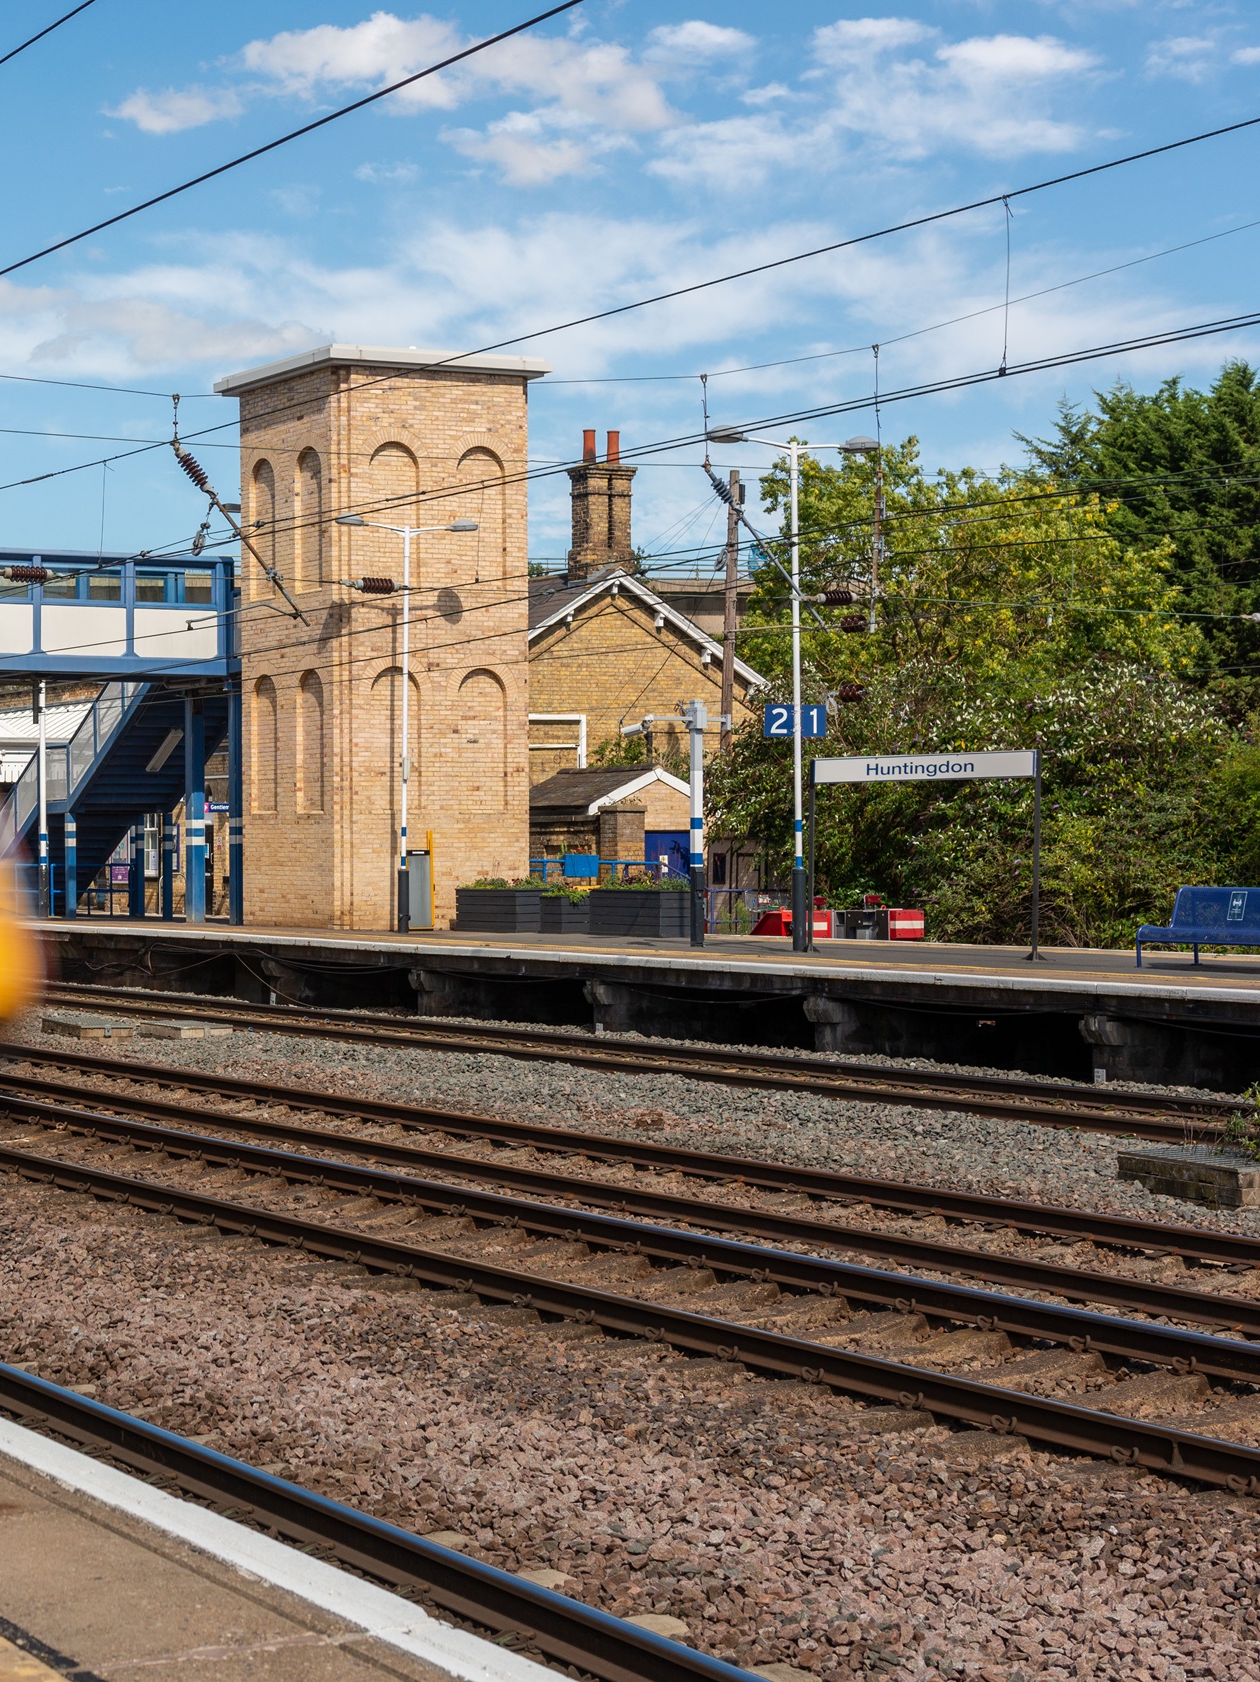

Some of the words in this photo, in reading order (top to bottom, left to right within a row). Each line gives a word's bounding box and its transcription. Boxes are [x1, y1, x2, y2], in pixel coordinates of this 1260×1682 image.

[770, 707, 788, 734] 2
[809, 708, 817, 734] 1
[866, 760, 975, 777] Huntingdon
